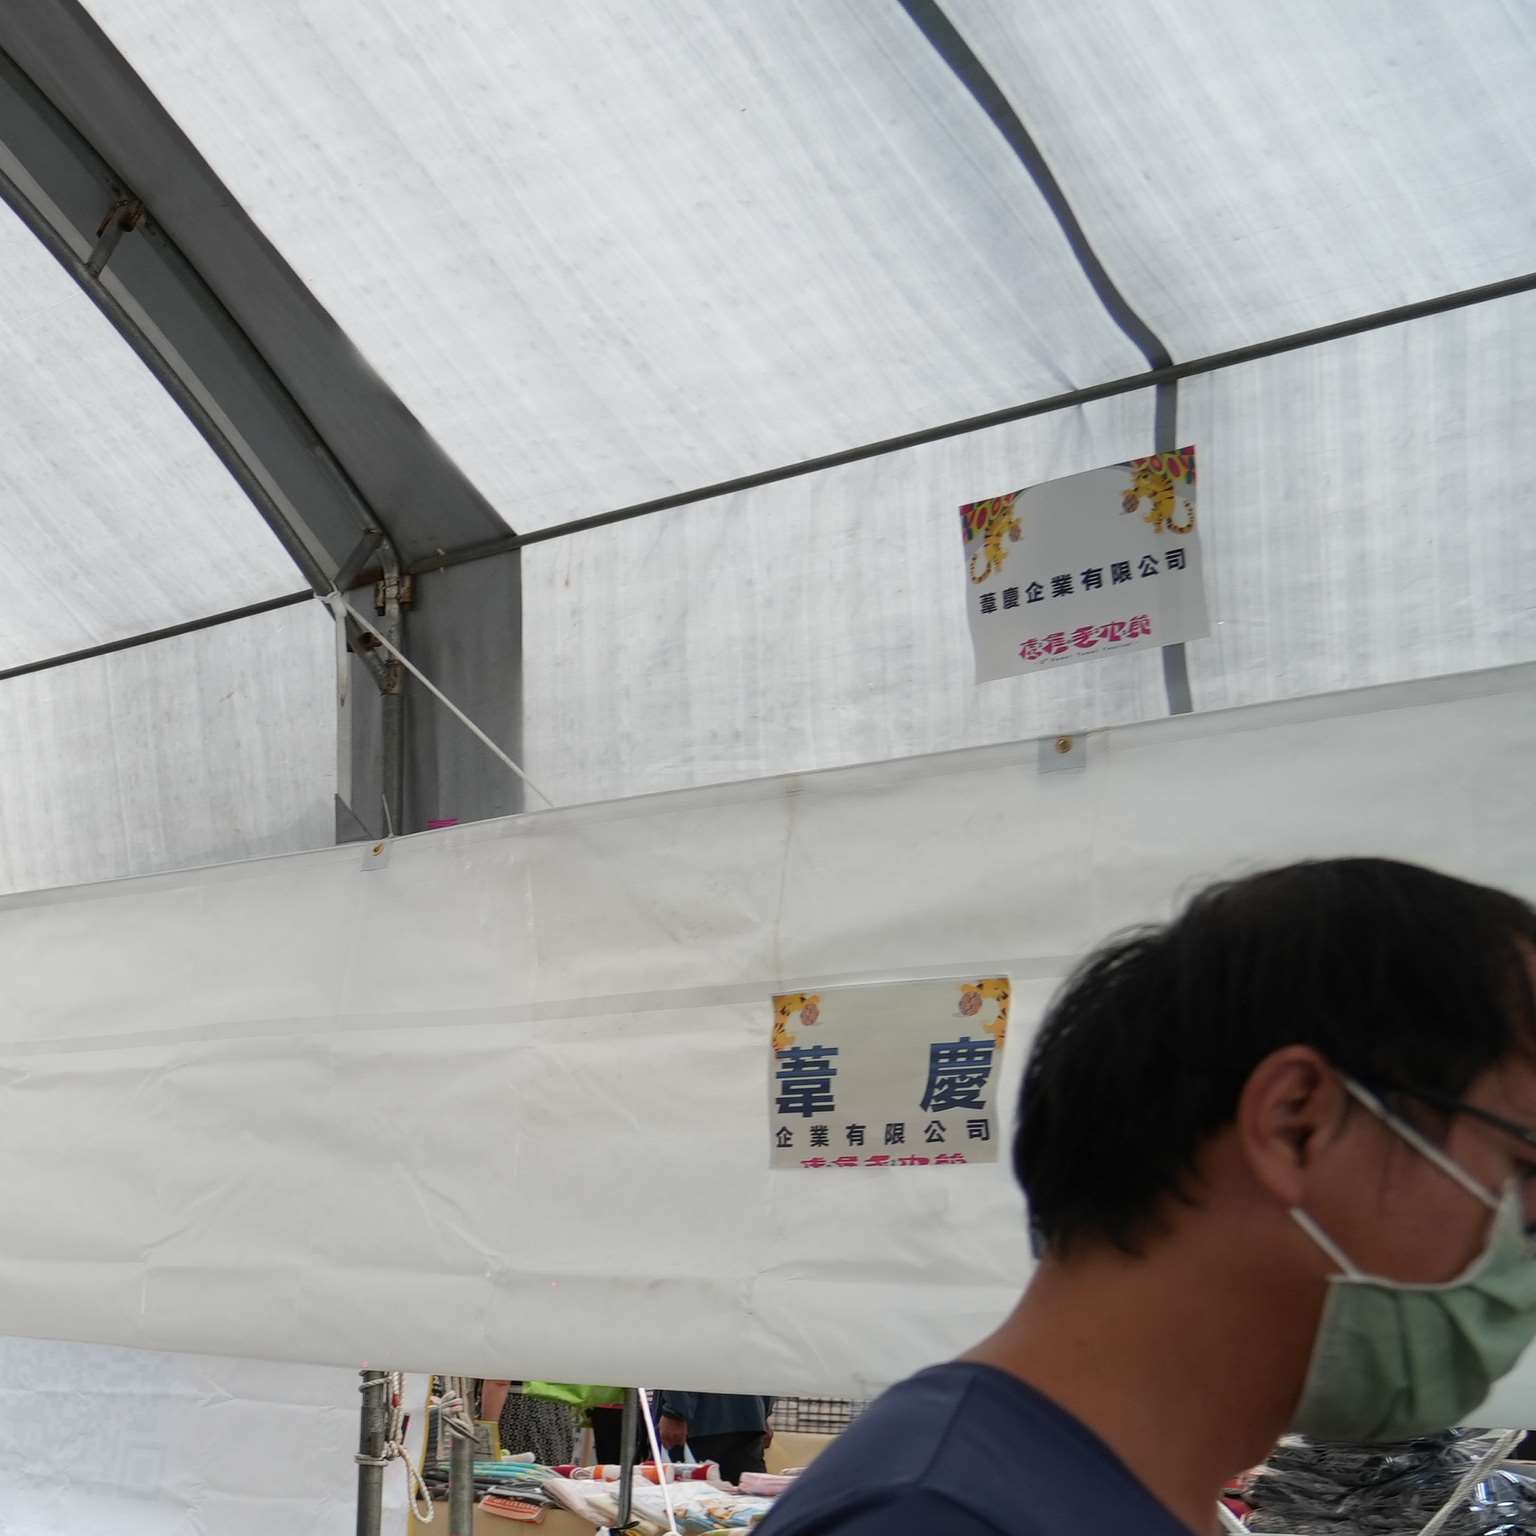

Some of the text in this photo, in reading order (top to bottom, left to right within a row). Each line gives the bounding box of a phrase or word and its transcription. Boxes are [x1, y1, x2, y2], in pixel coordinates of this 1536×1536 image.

[775, 1118, 990, 1149] 企業有限公司
